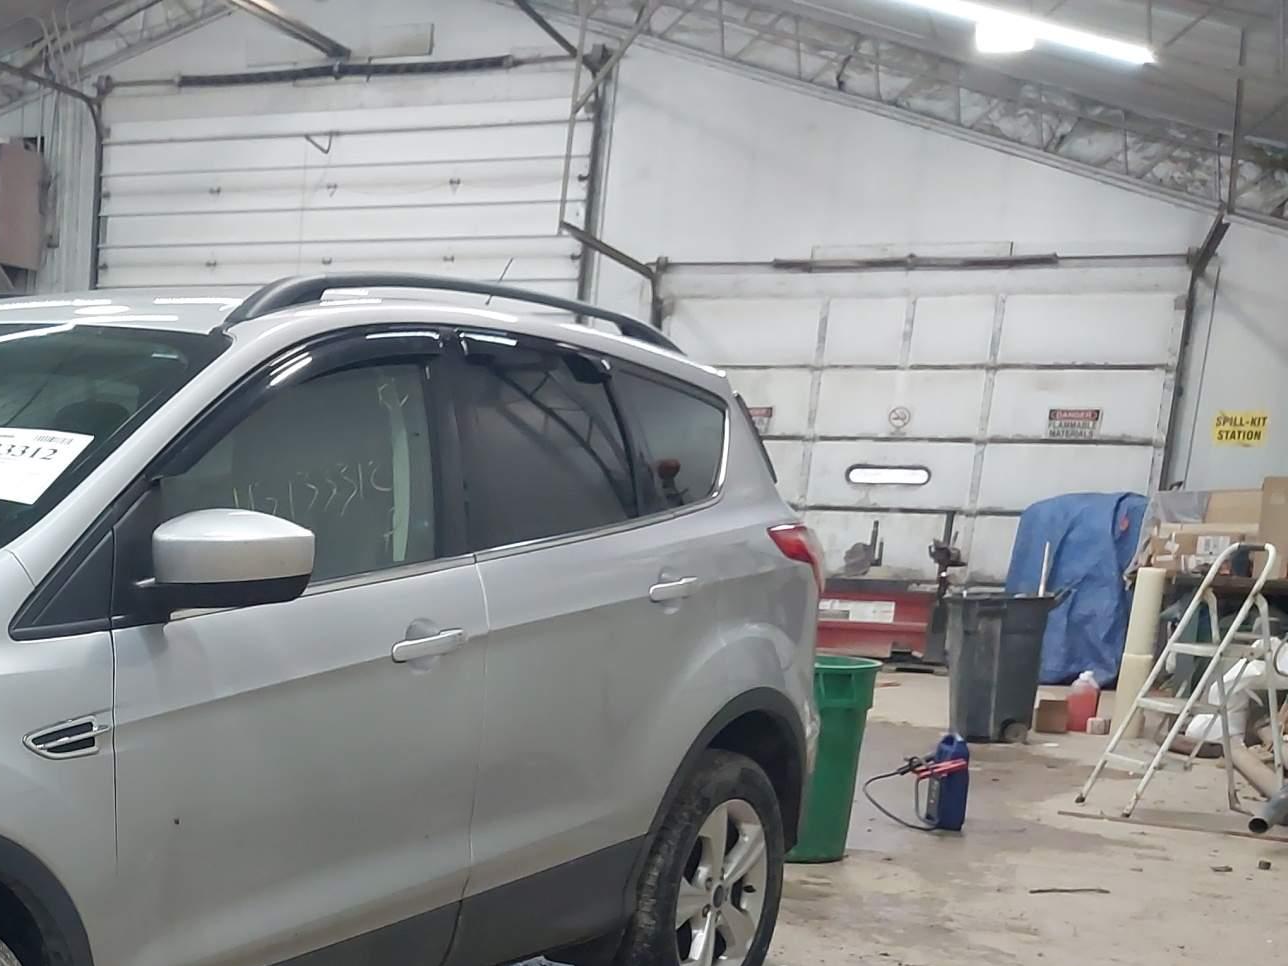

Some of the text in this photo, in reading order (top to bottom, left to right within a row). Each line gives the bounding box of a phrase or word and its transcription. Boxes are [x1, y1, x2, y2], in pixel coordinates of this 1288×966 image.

[1048, 420, 1097, 430] FLAMMABLE
[1216, 415, 1268, 427] SPILL-KIT
[1048, 430, 1094, 438] MATERIALS
[1217, 430, 1262, 441] STATION
